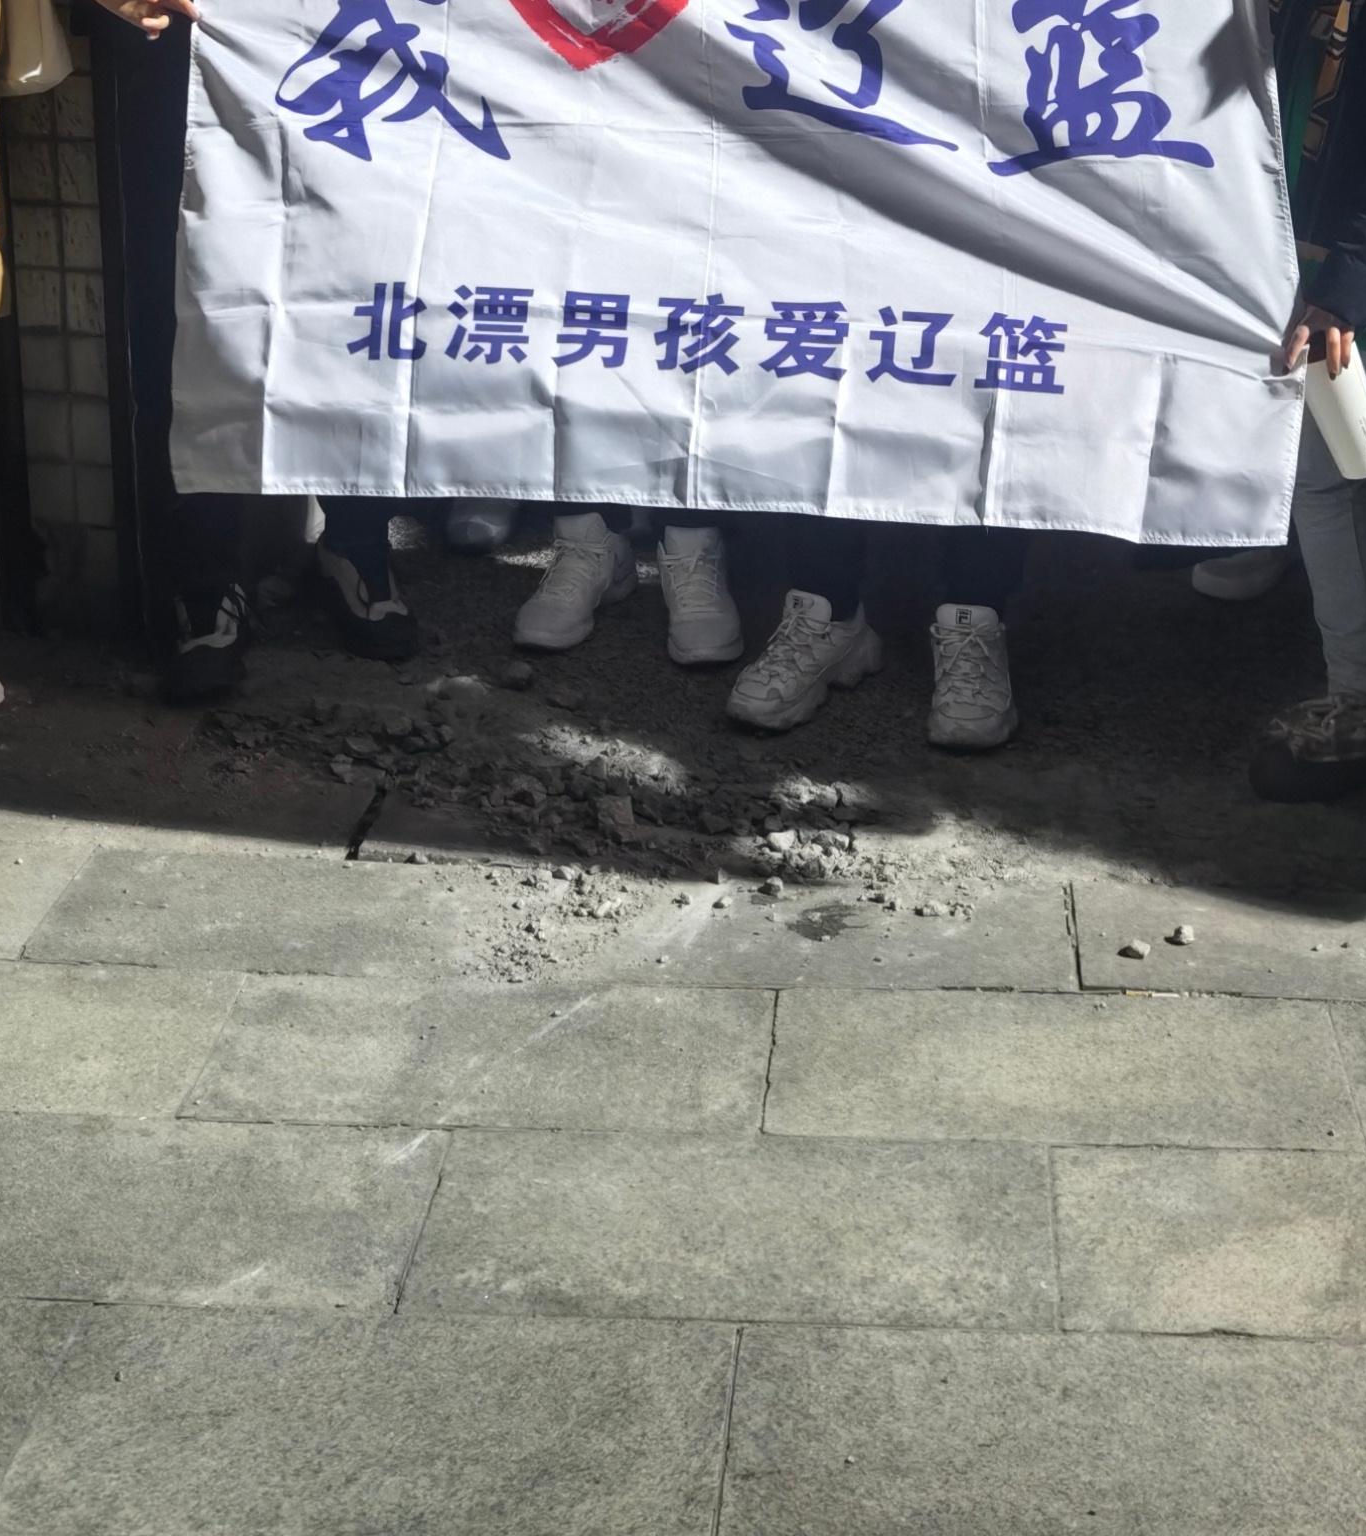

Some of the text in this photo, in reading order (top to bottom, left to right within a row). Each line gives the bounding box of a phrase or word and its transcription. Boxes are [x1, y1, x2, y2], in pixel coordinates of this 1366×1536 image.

[347, 282, 1068, 395] 北漂男孩爱辽篮
